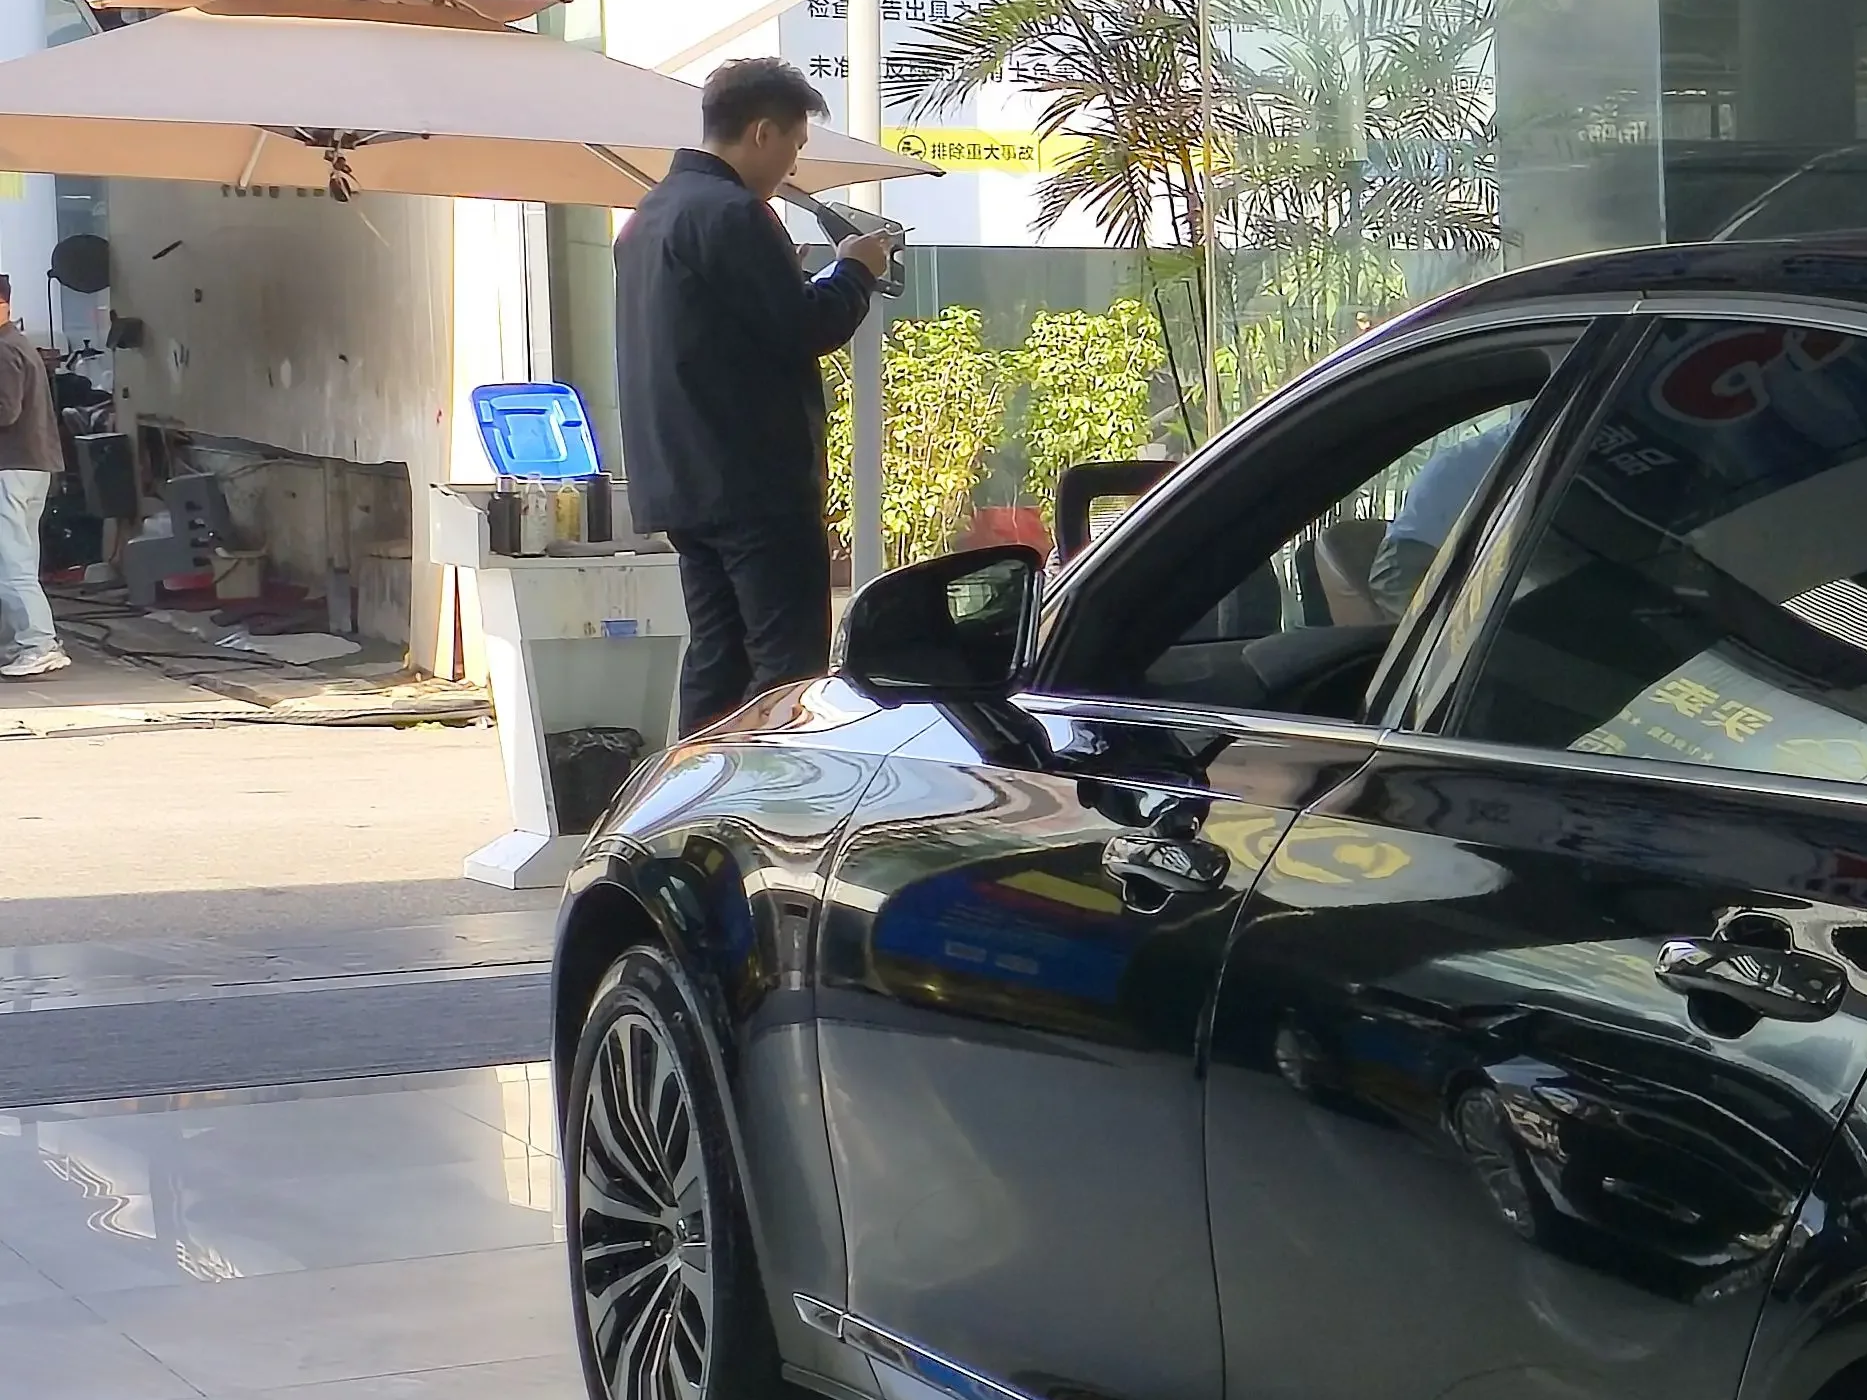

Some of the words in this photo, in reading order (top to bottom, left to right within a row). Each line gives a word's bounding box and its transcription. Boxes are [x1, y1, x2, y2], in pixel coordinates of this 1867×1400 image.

[931, 141, 1034, 161] 排除重大事故
